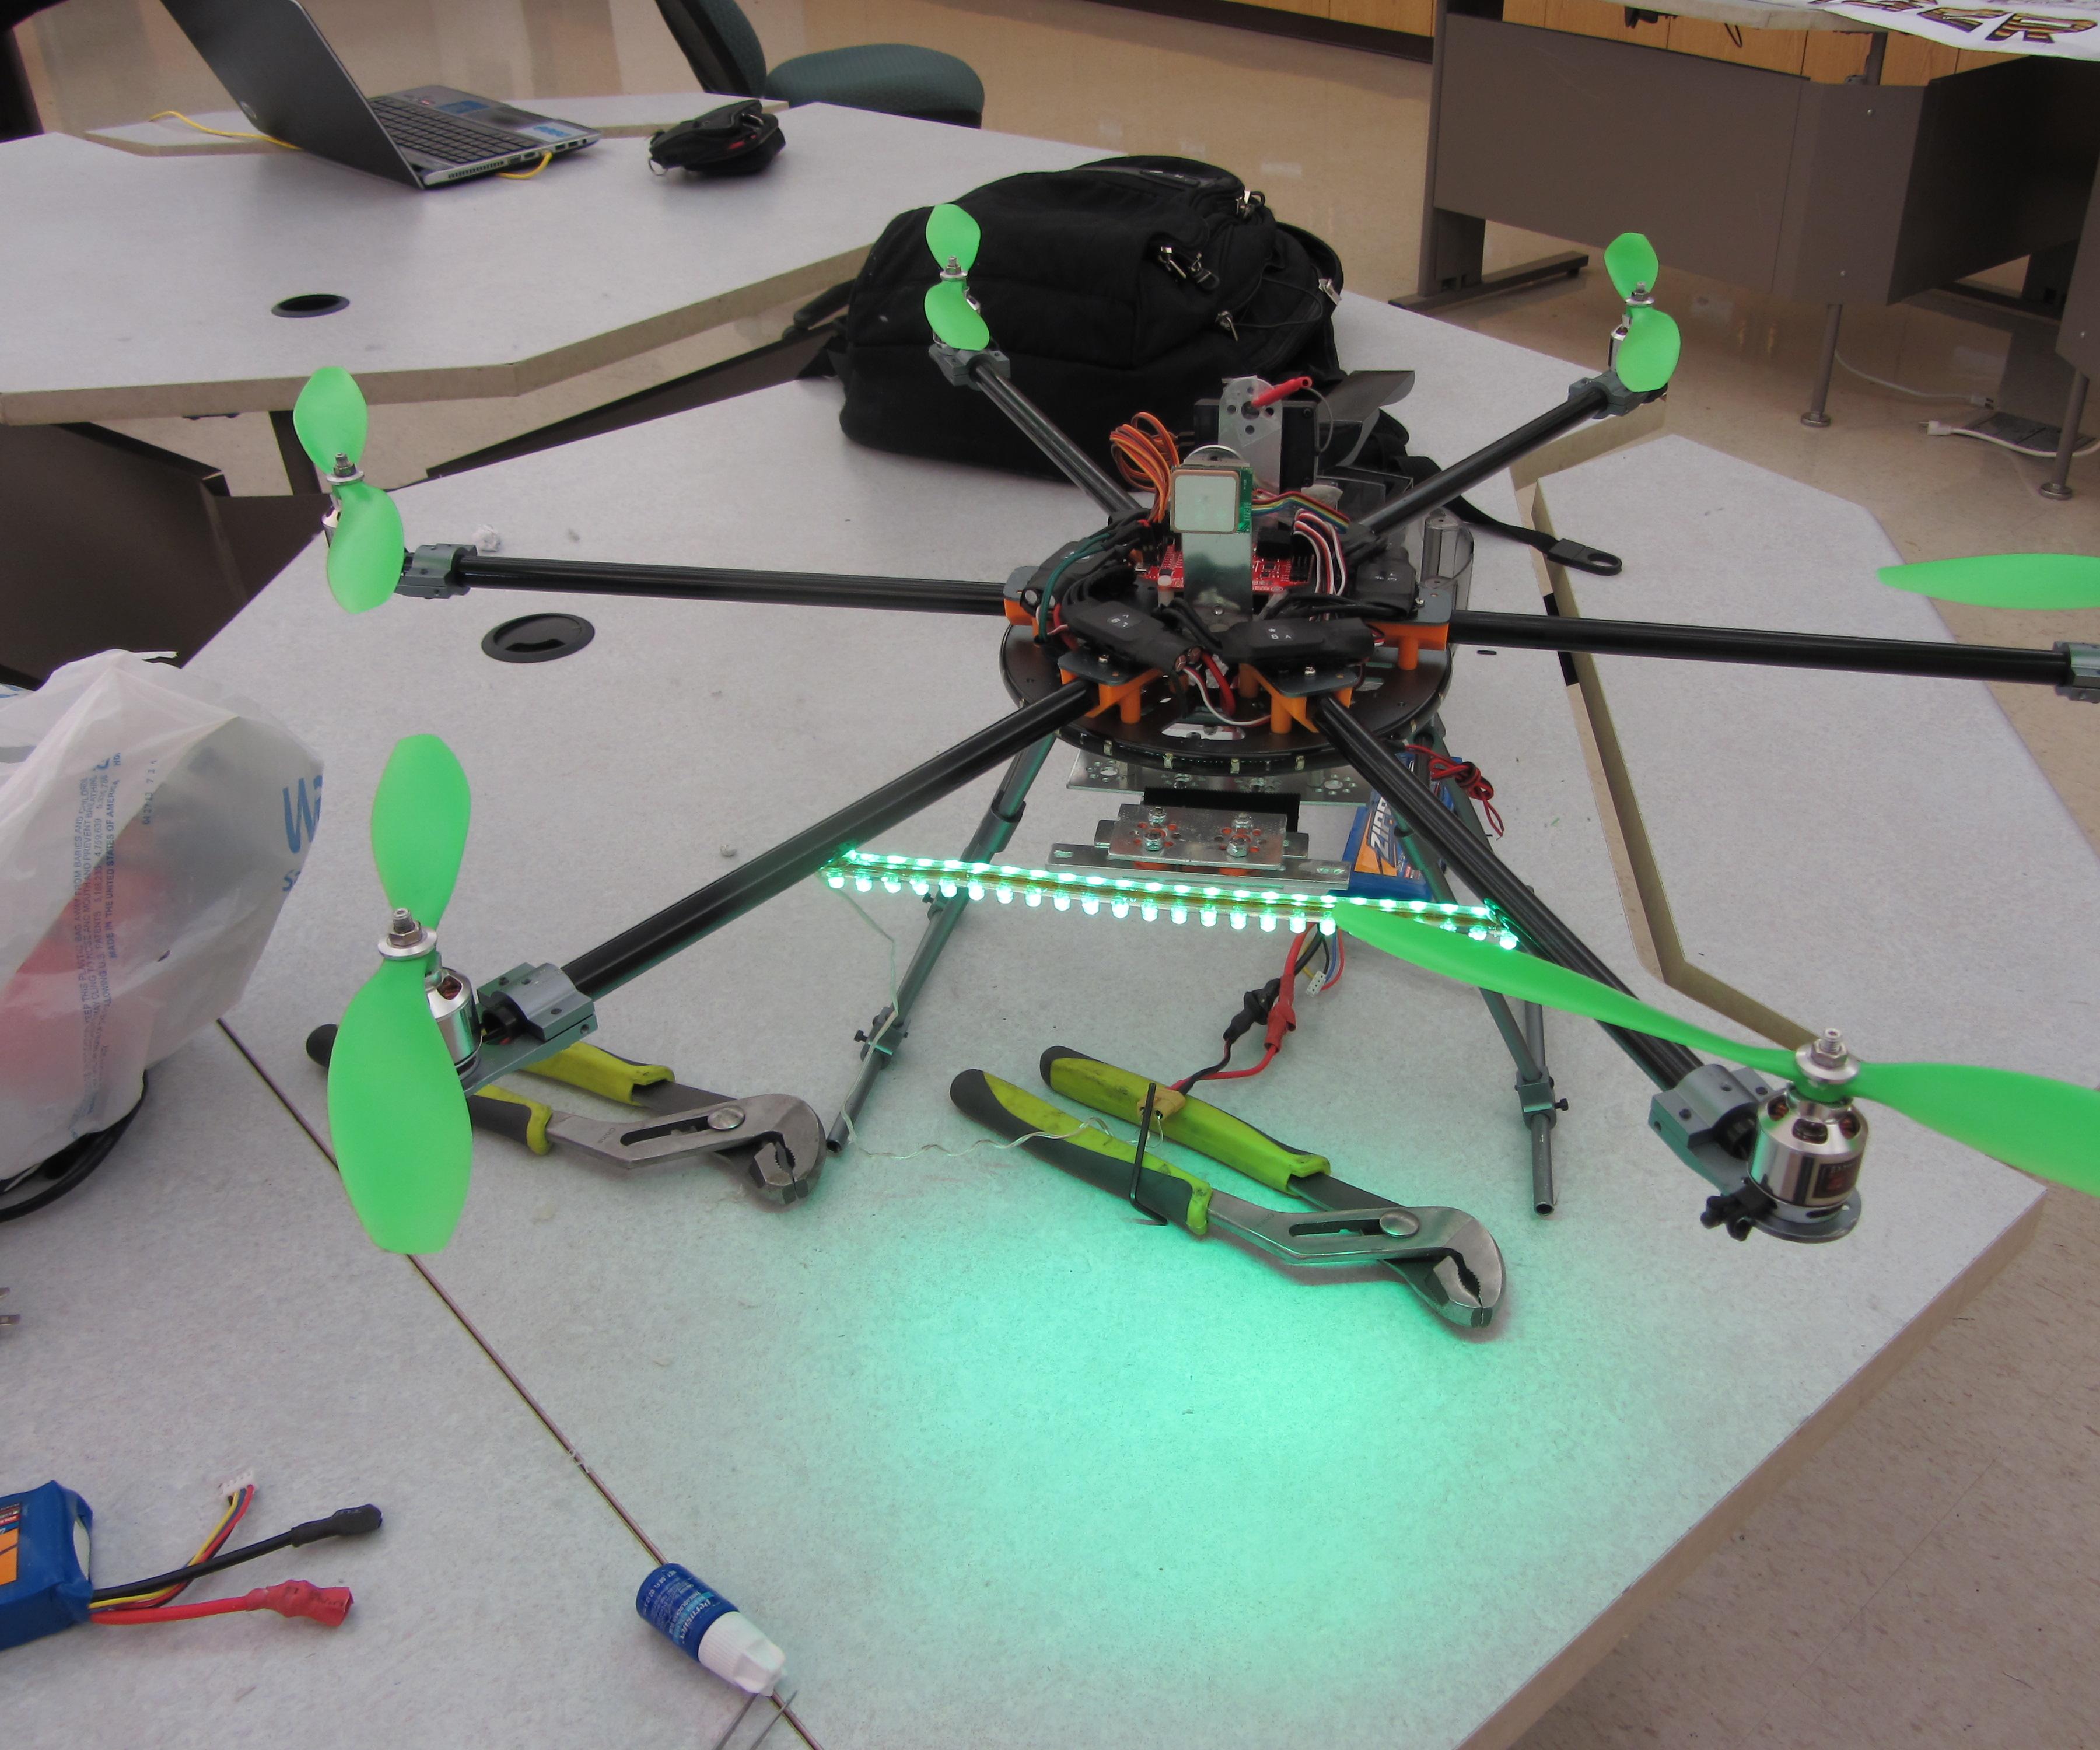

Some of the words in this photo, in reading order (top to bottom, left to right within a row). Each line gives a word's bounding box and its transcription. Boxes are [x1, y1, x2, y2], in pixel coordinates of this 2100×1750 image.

[75, 817, 83, 834] AND
[106, 821, 114, 831] OF
[106, 834, 114, 866] STATES
[94, 912, 103, 949] PATENTS
[106, 933, 117, 958] MADE
[80, 984, 89, 1002] THIS
[88, 975, 99, 999] CLING
[598, 1128, 616, 1144] China
